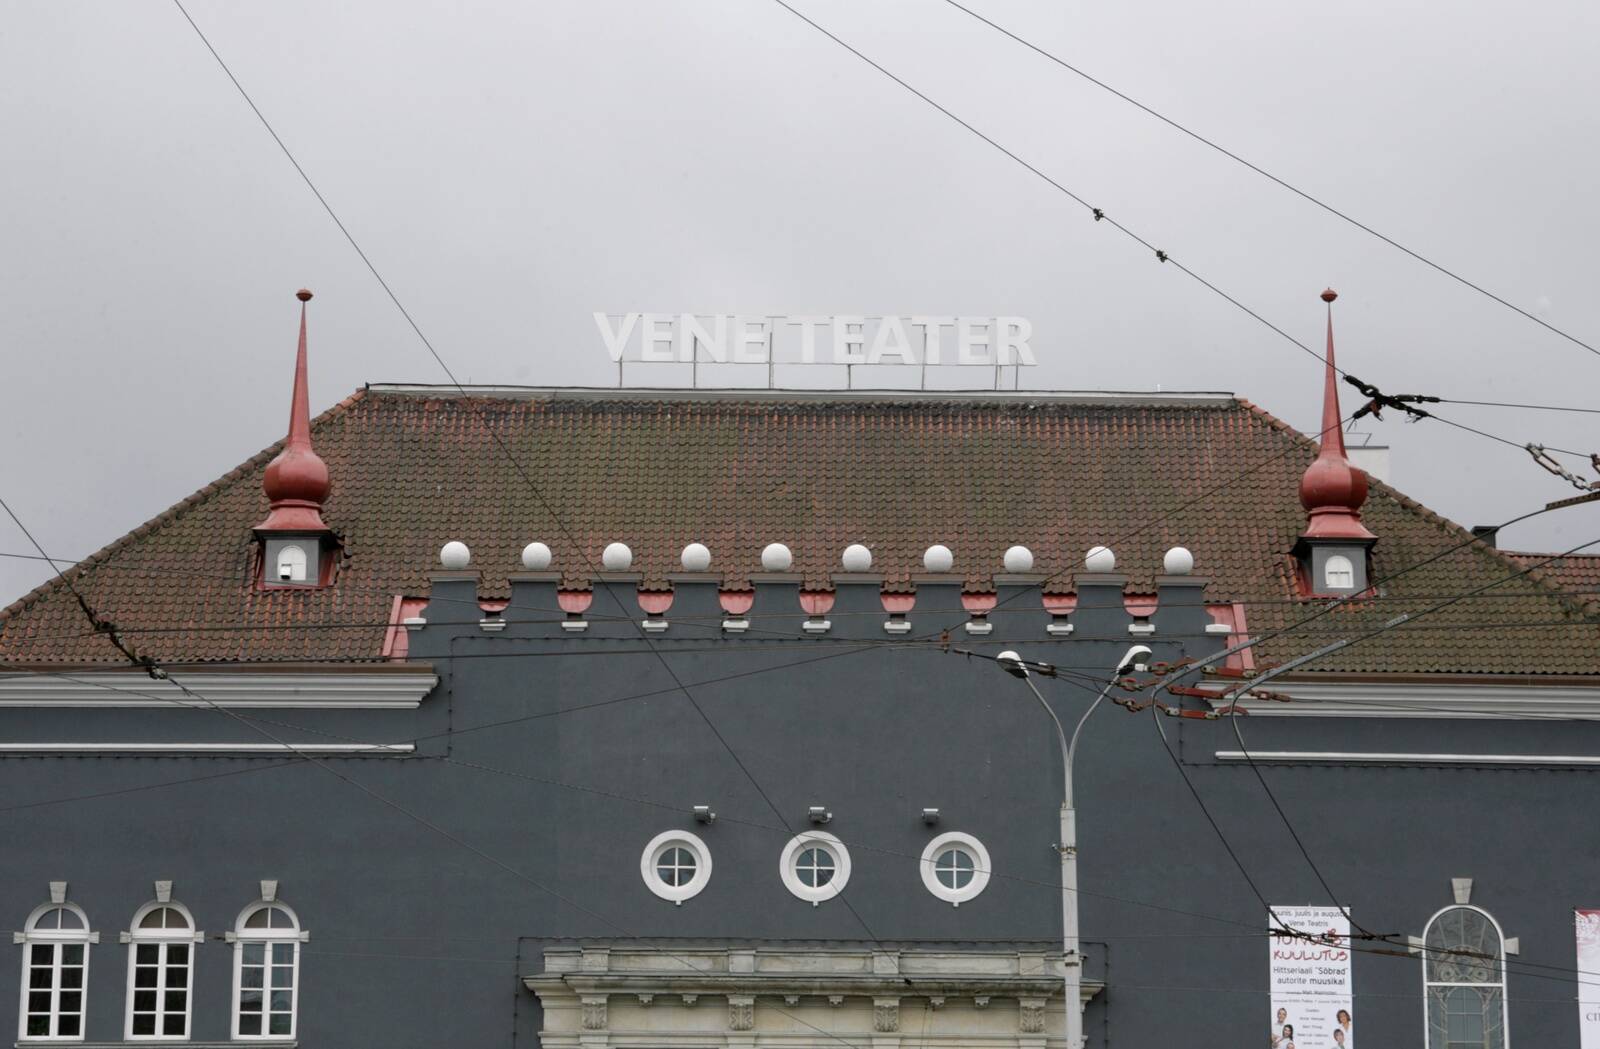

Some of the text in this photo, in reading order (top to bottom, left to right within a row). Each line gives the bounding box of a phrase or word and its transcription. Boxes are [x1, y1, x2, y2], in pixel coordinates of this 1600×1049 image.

[594, 312, 1037, 366] VENE TEATER
[1308, 919, 1329, 927] Teatris
[1273, 949, 1348, 961] KUULUTUS
[1277, 977, 1345, 985] autorite muusikal
